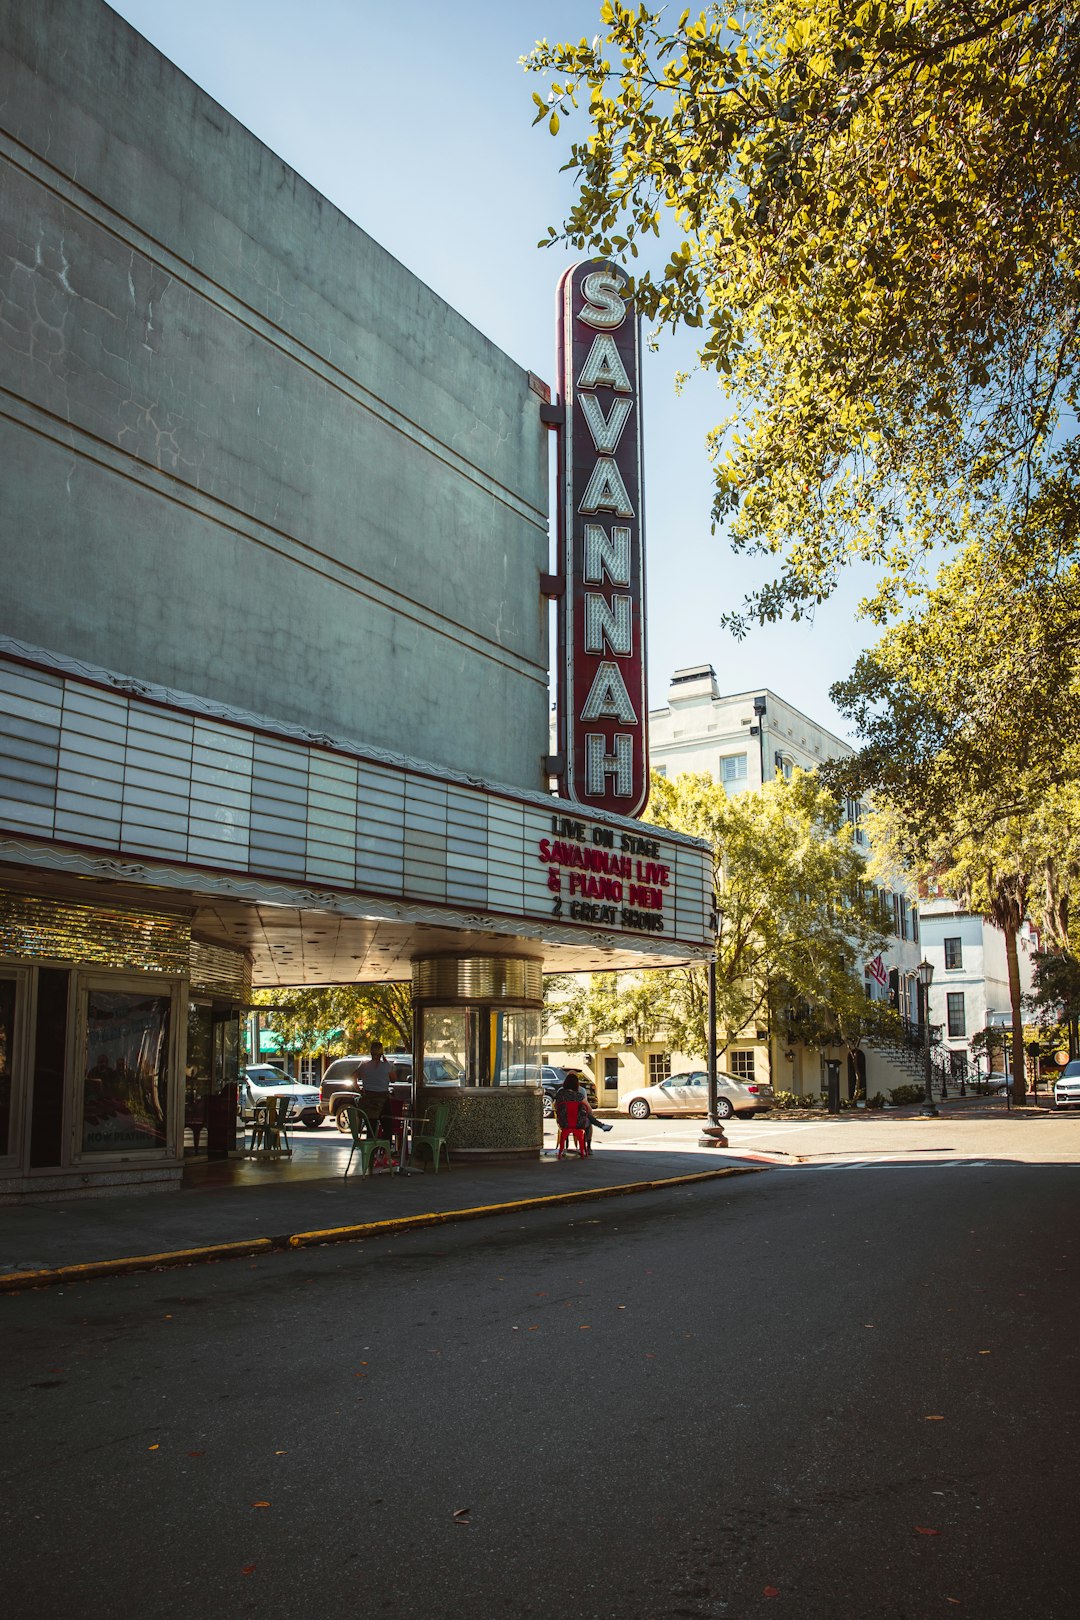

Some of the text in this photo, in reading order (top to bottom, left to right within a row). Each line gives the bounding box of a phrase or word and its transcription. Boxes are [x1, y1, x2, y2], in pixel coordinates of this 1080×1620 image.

[577, 271, 638, 797] SAVANNAH
[552, 815, 661, 860] LIVE ON STAGE
[538, 838, 670, 887] SAVANNAH LIVE
[569, 871, 623, 903] PIANO
[629, 883, 663, 911] MEN
[552, 896, 664, 932] 2 GREAT SHOWS
